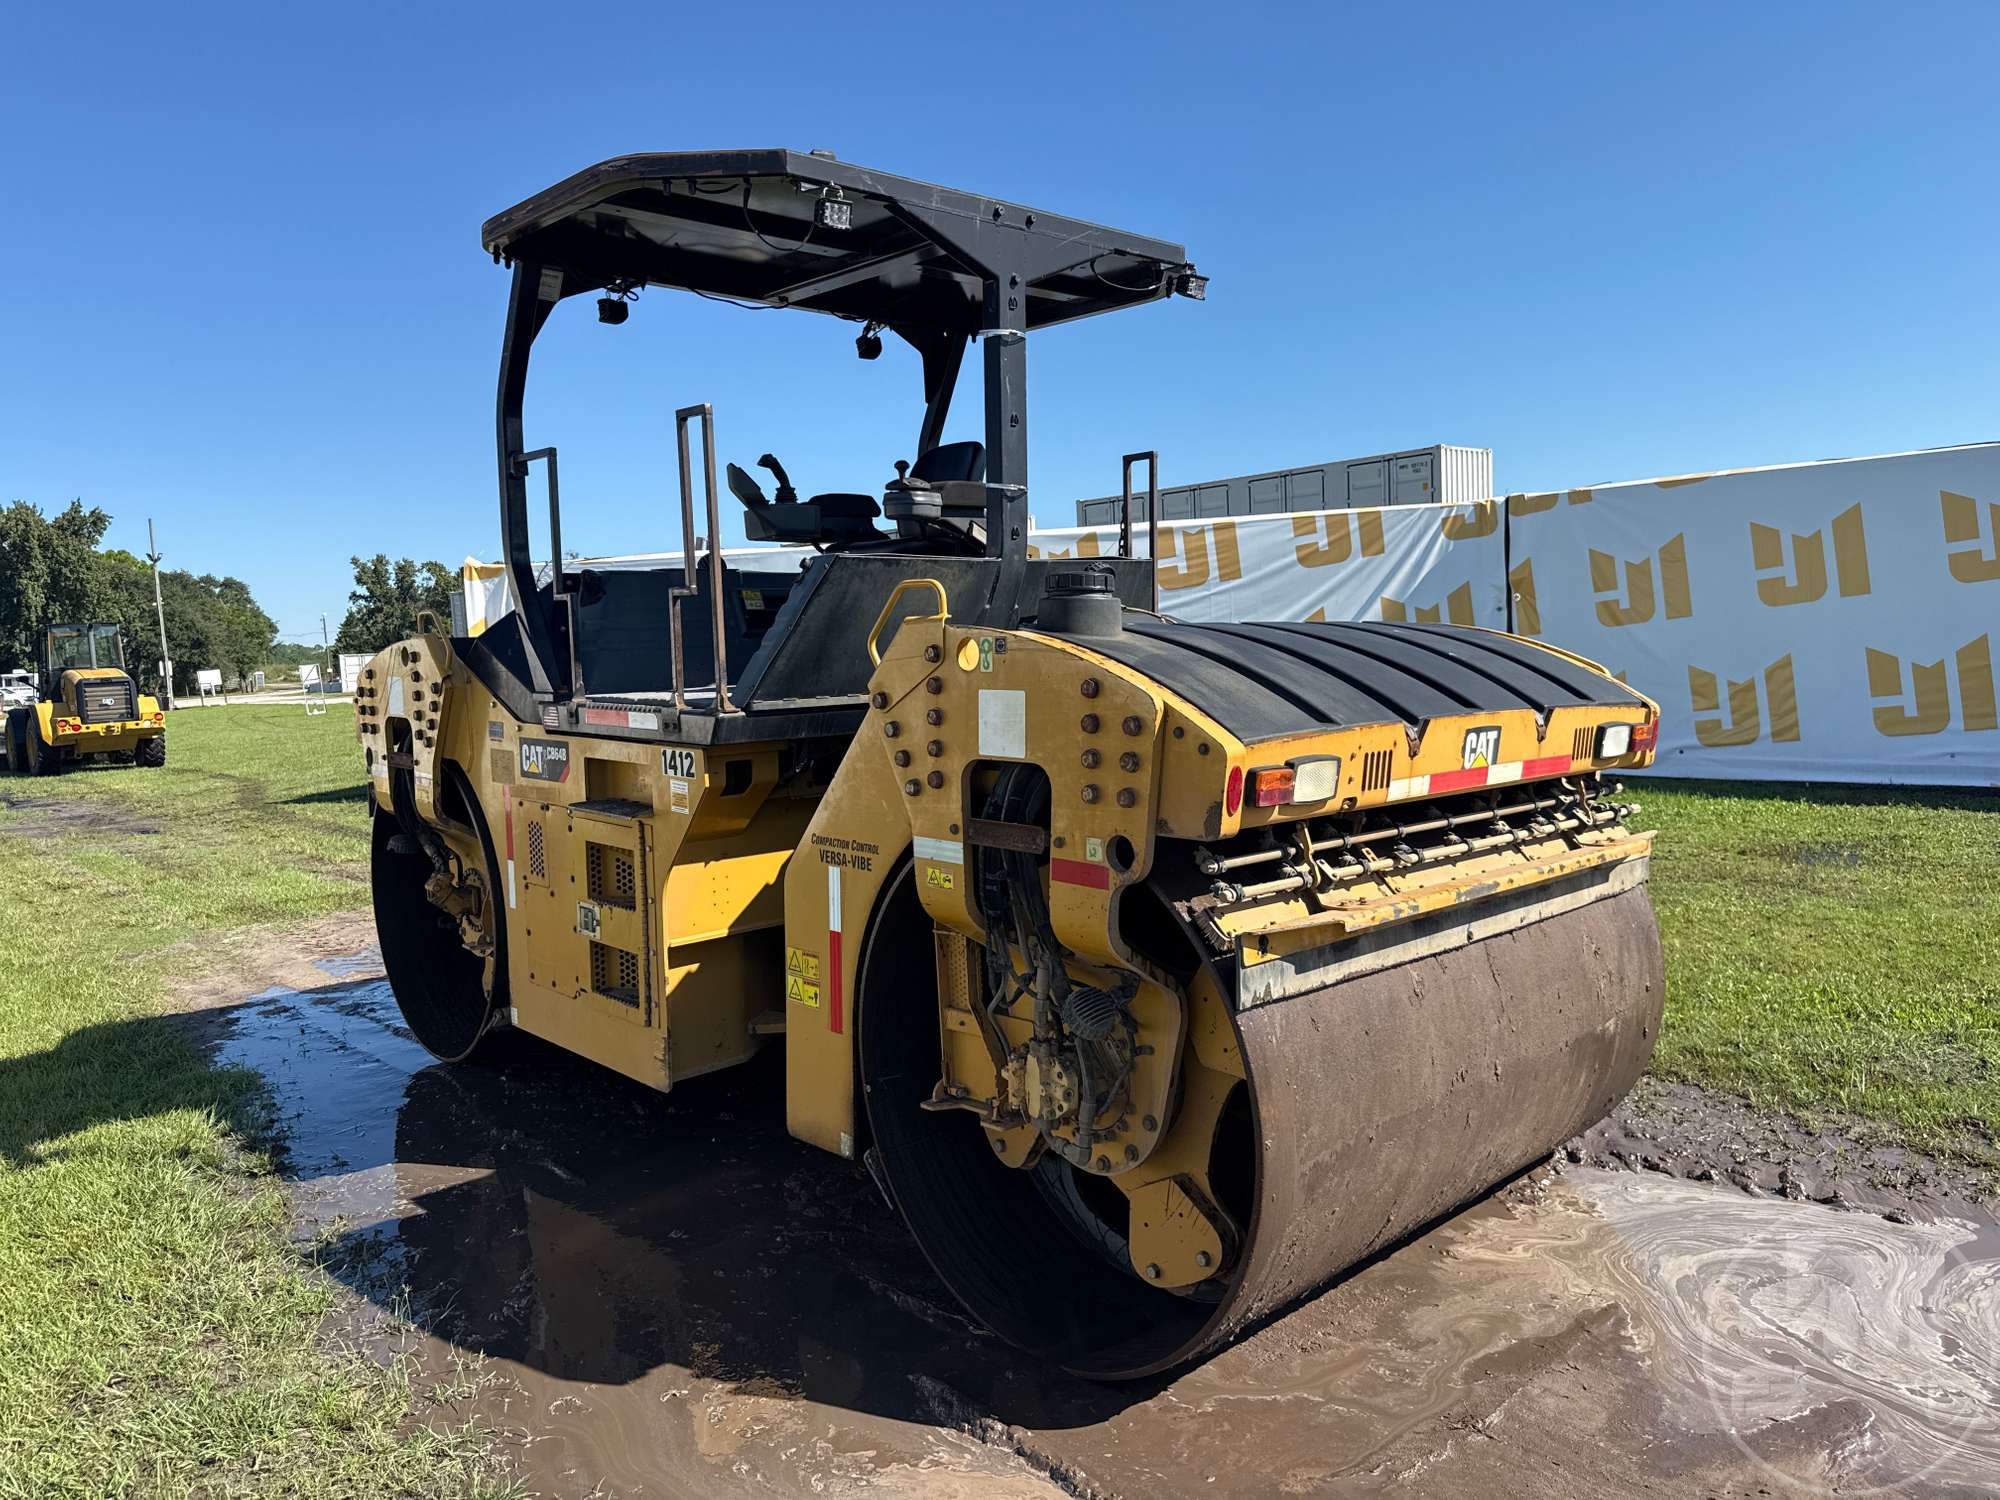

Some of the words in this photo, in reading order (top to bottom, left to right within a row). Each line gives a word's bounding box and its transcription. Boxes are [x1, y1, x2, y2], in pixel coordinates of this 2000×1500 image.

[521, 743, 543, 774] CAT
[662, 749, 695, 778] 1412
[1464, 730, 1499, 769] CAT
[820, 848, 872, 872] VERSA-VIBE
